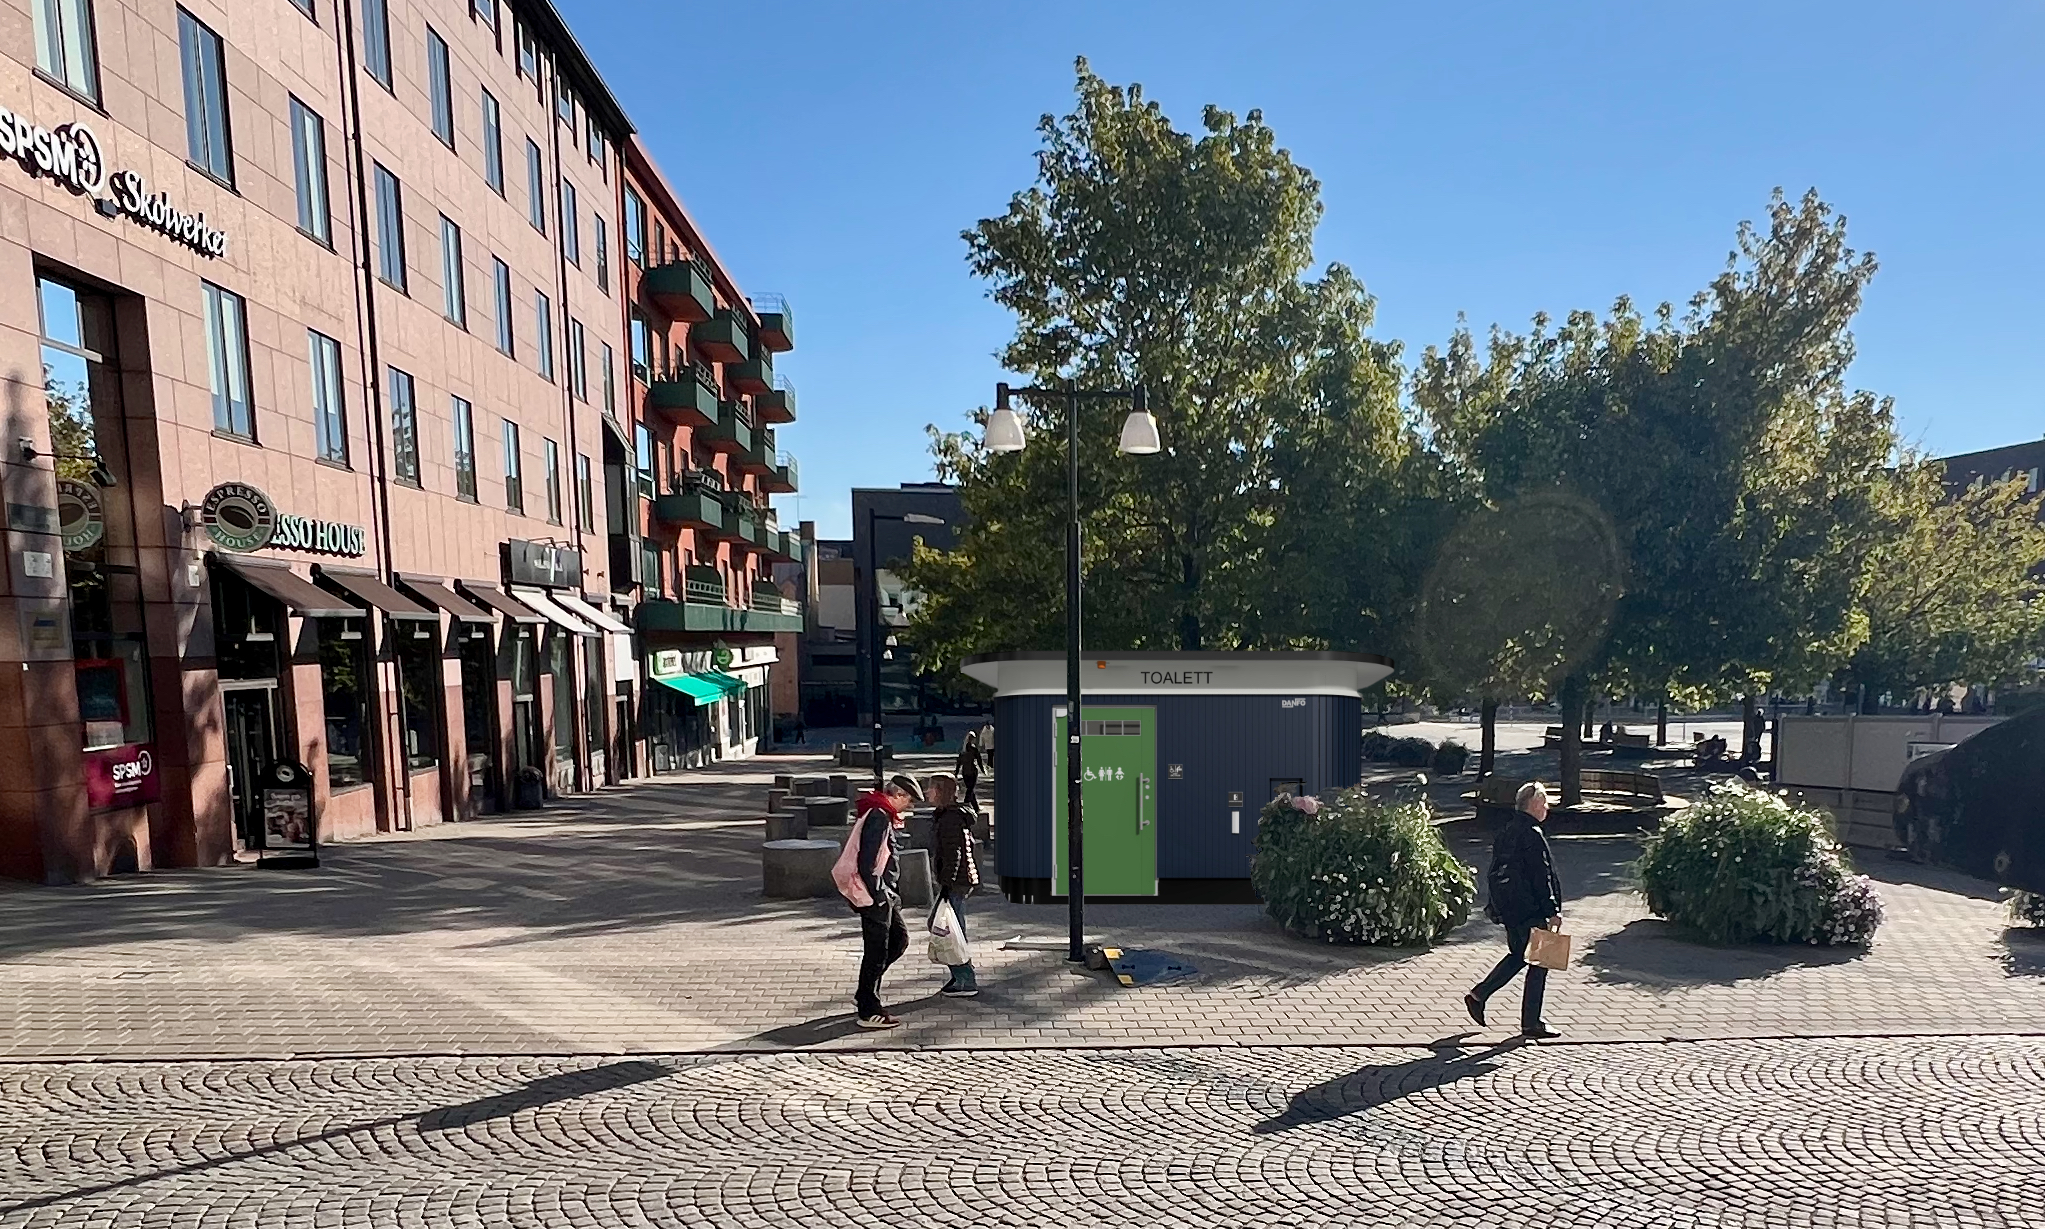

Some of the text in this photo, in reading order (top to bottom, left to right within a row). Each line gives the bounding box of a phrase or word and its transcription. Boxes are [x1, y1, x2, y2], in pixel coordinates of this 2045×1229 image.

[0, 106, 79, 187] SPSM
[205, 486, 268, 513] ESPRESSO
[213, 530, 263, 548] HOUSE
[316, 519, 366, 555] HOUSE
[1140, 671, 1213, 684] TOALETT
[1281, 697, 1307, 708] DANFO
[112, 761, 142, 780] SPSM
